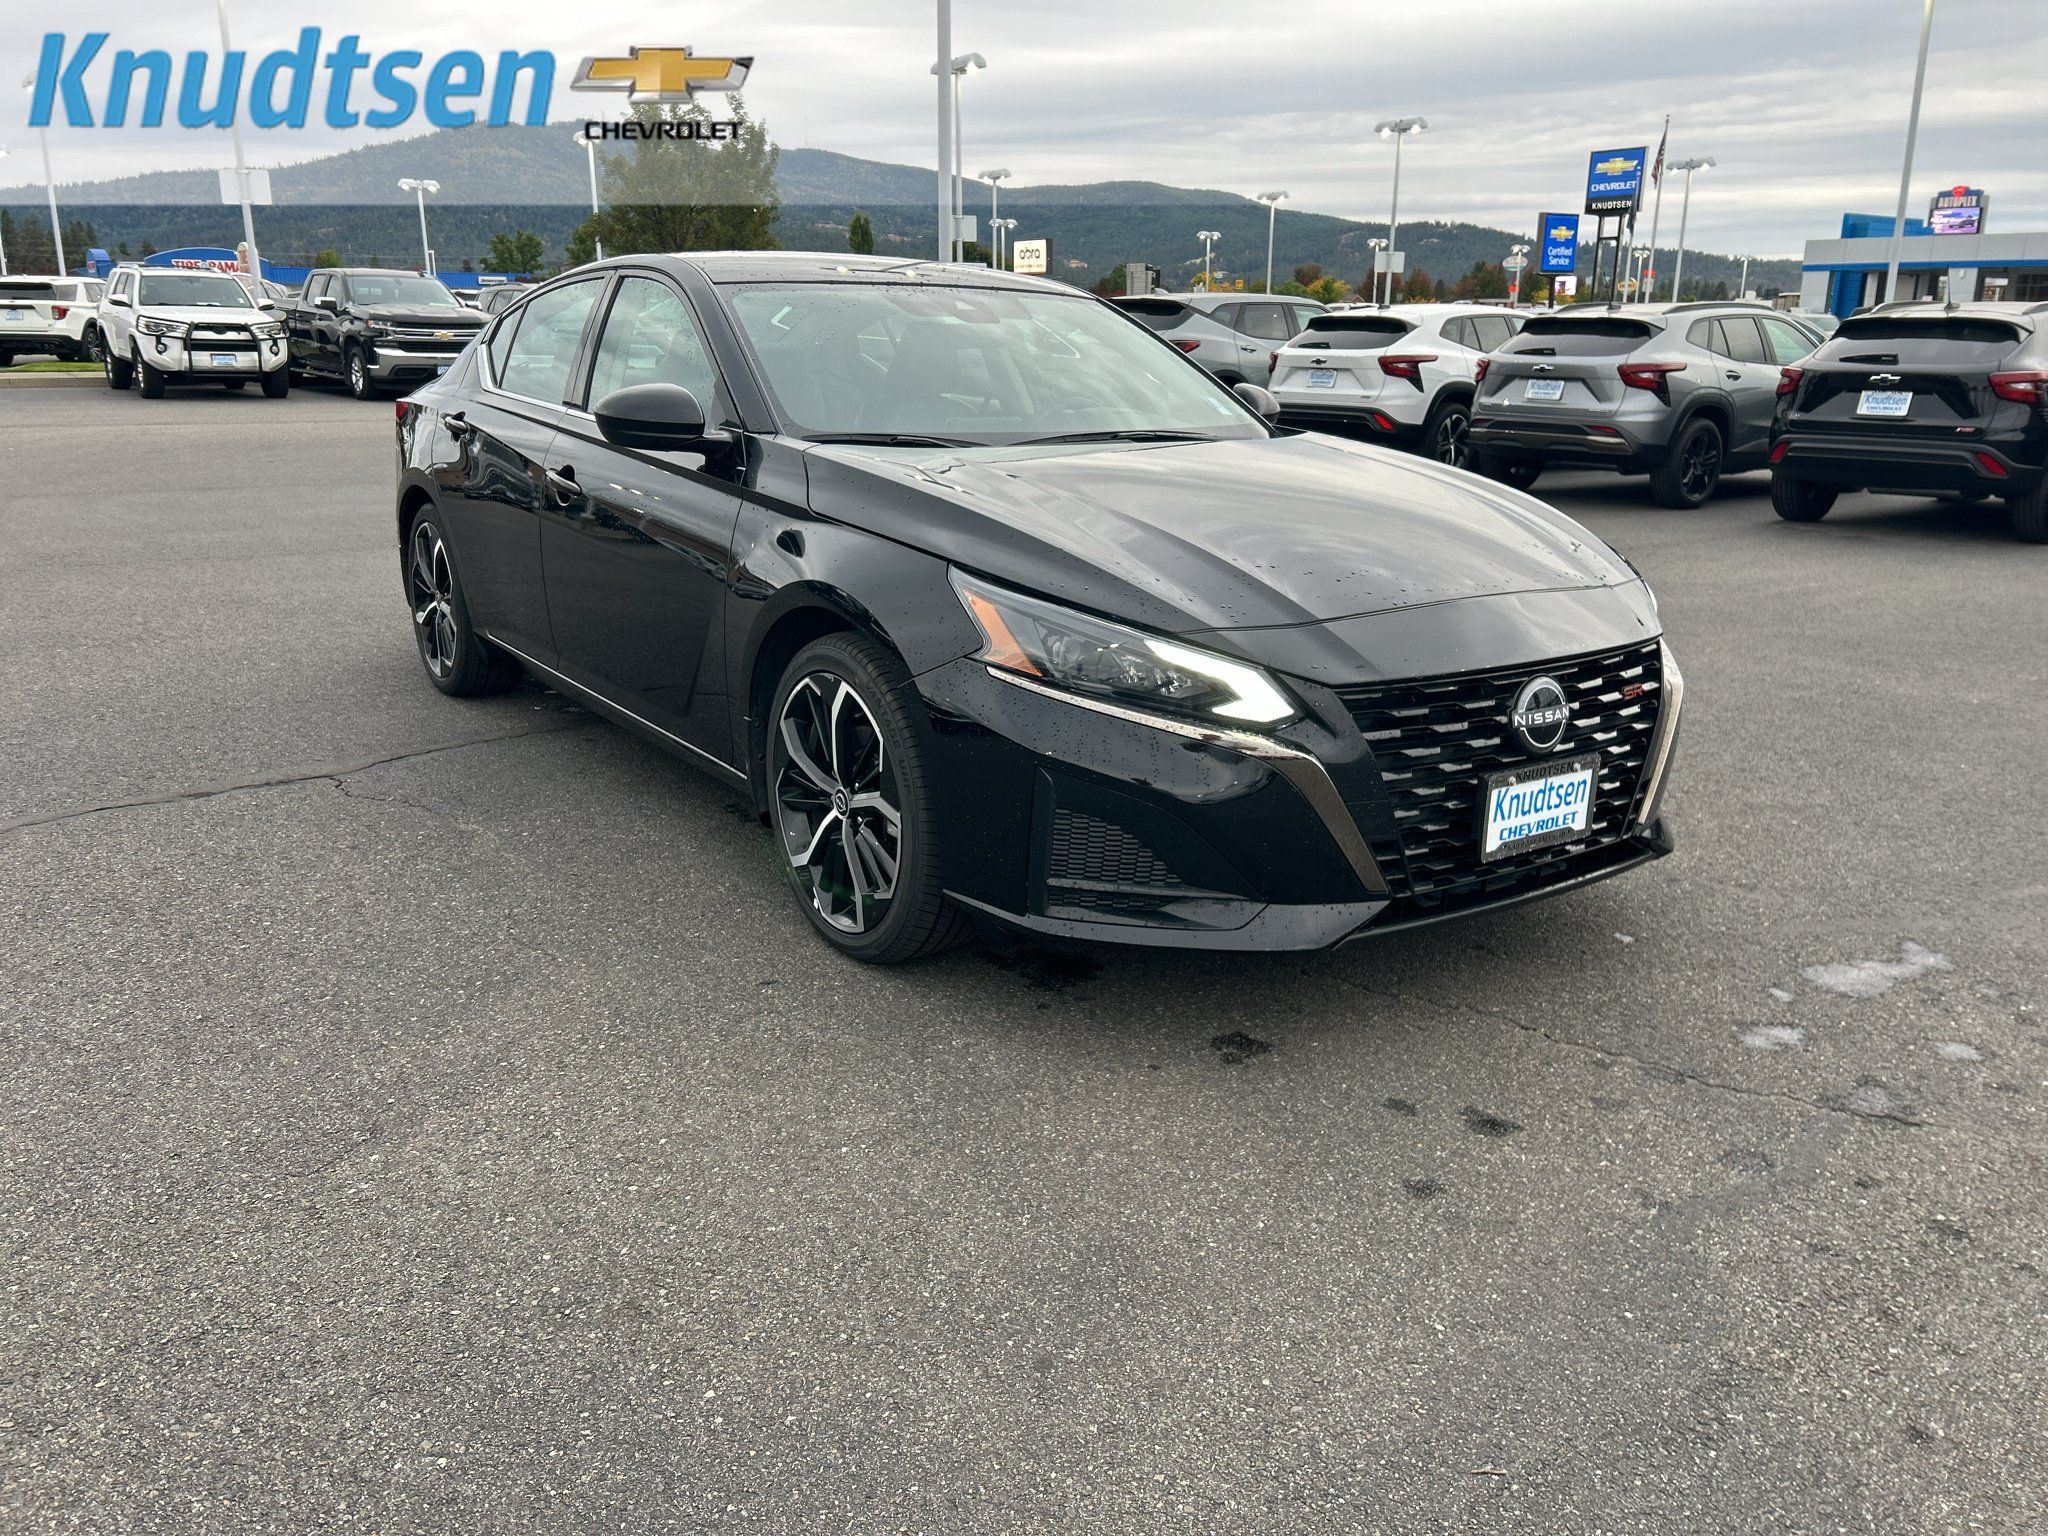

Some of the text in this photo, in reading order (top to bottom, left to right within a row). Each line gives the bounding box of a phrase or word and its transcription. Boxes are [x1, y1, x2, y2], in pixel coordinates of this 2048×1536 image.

[1591, 181, 1637, 192] CHEVROLET
[1592, 200, 1632, 210] KNUDTSEN
[1548, 246, 1572, 257] Certified
[1549, 257, 1570, 266] Service
[1864, 393, 1908, 406] Knudtsen
[1622, 683, 1643, 700] SR
[1514, 705, 1569, 727] NISSAN
[1515, 761, 1575, 781] KNUDTSEN
[1493, 777, 1588, 823] Knudtsen
[1498, 811, 1579, 841] CHEVROLET
